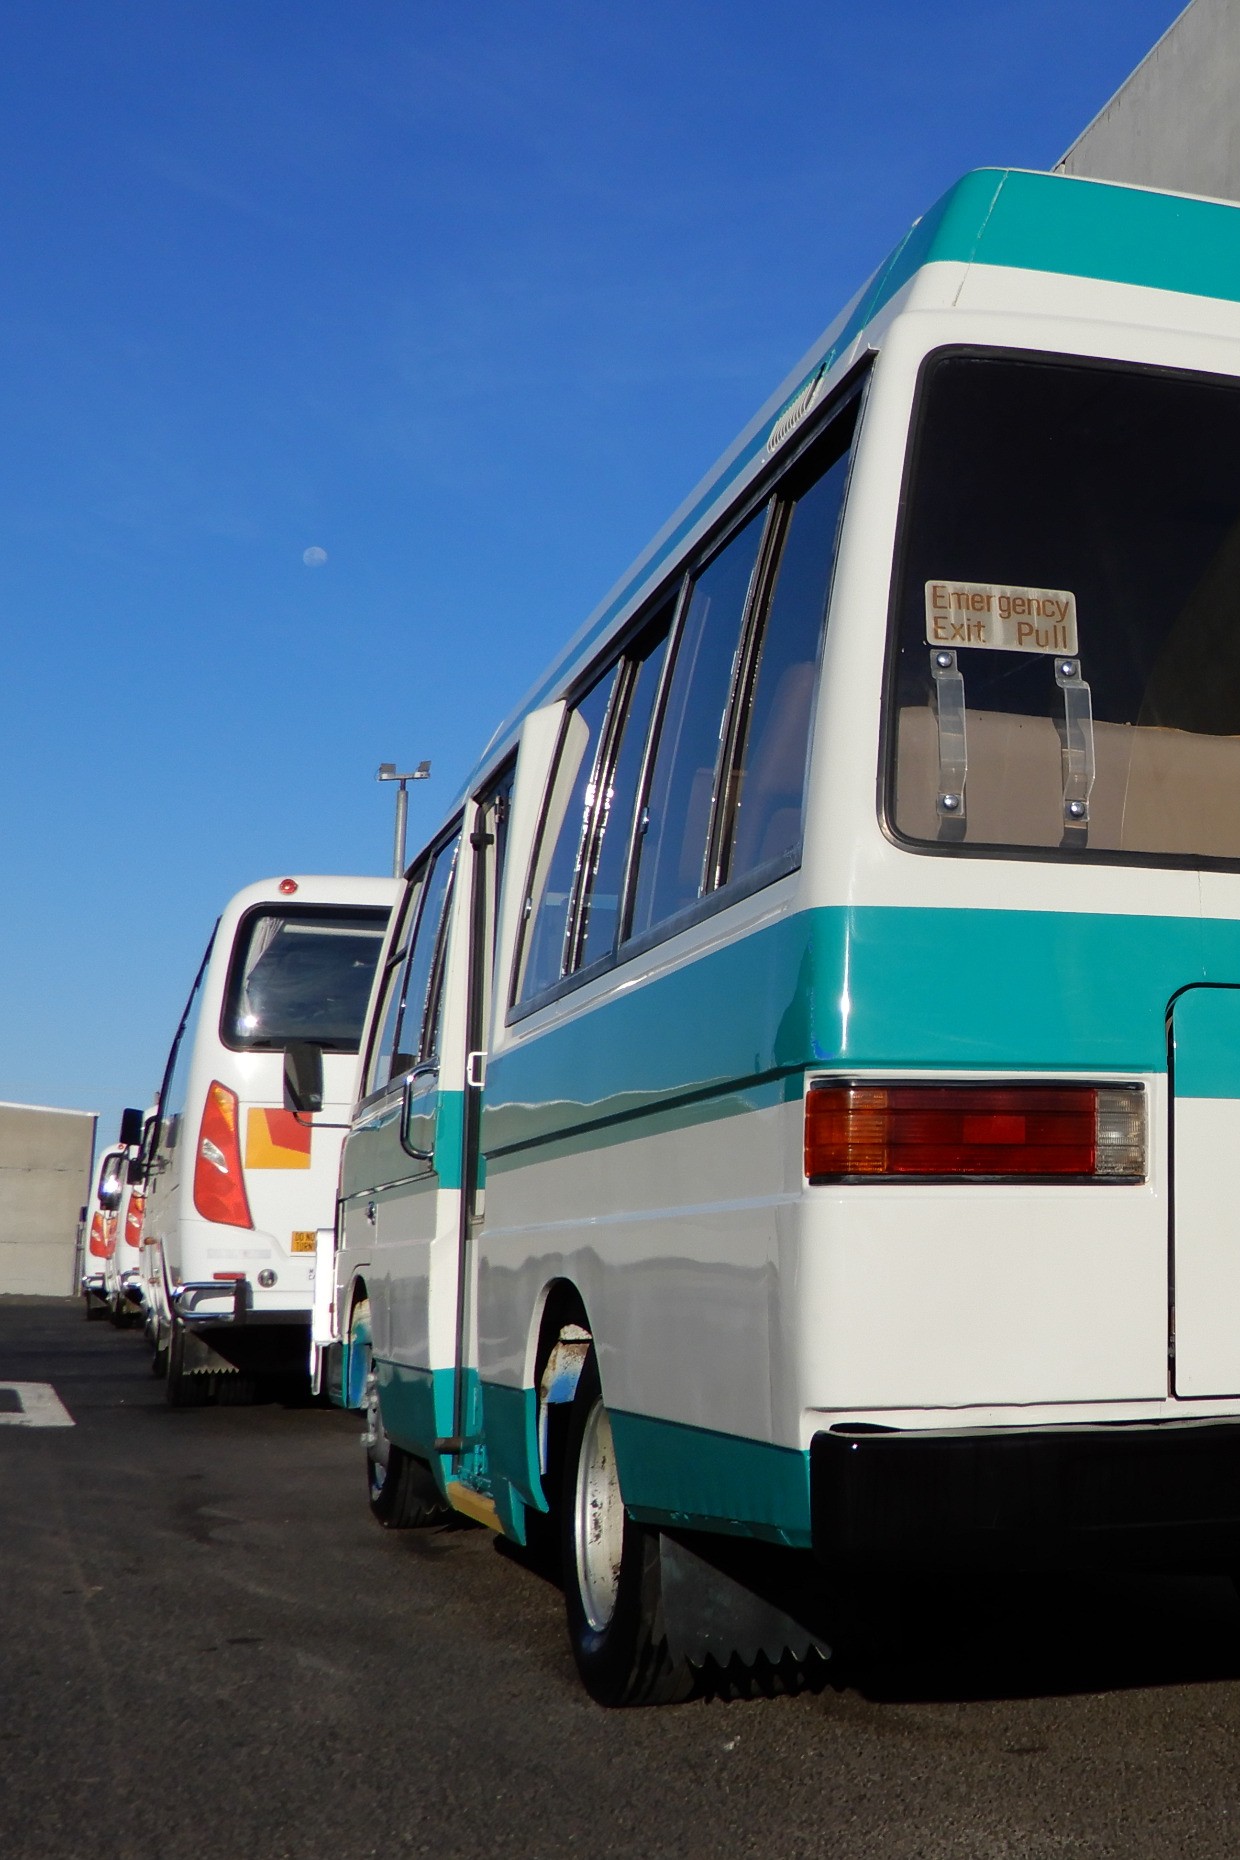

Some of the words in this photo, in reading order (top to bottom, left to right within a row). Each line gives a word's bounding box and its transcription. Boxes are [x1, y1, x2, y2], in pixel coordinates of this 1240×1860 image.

[932, 585, 1069, 623] Emergency
[933, 616, 986, 643] Exit
[1017, 621, 1068, 650] Pull
